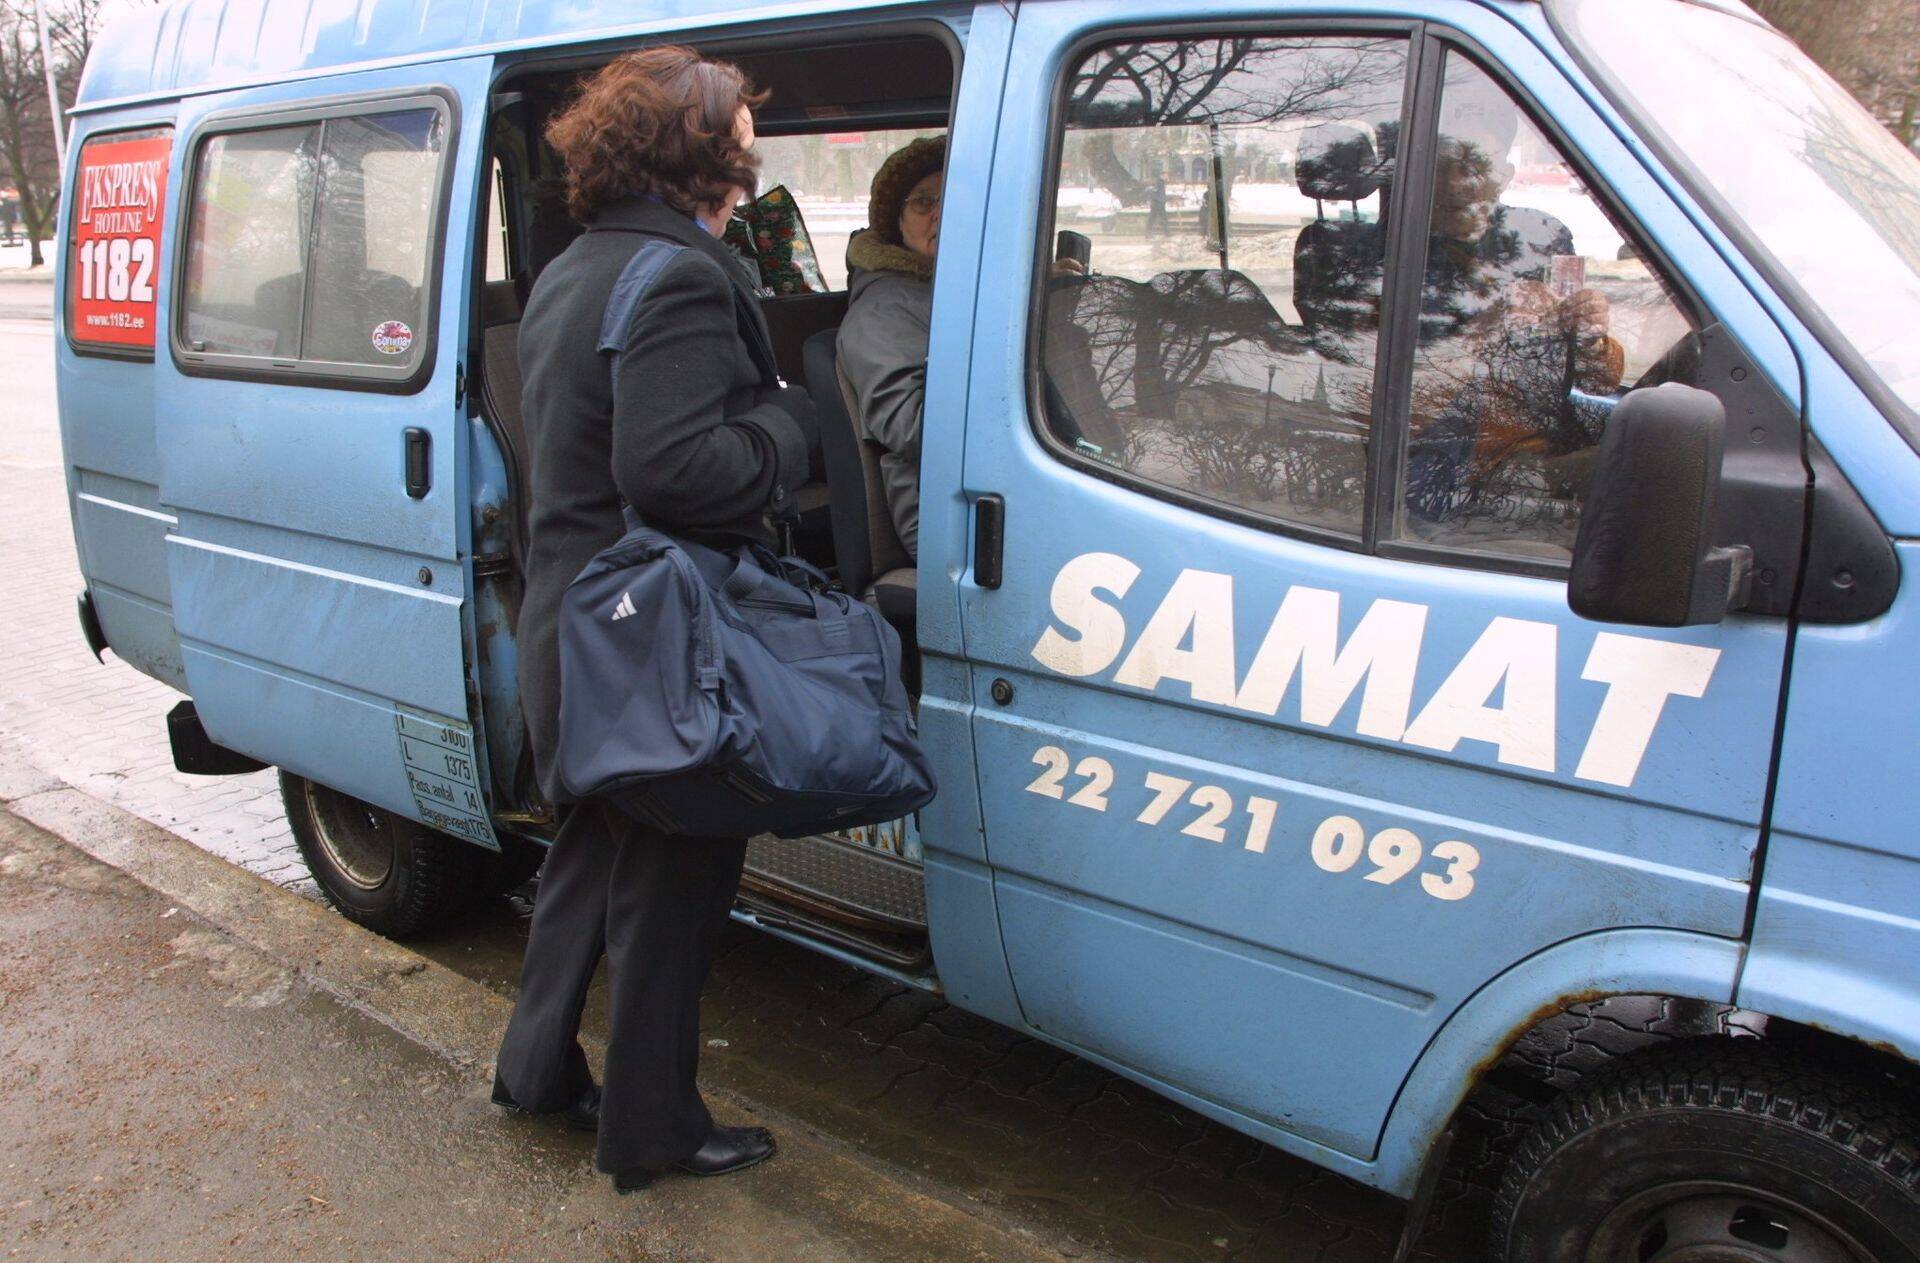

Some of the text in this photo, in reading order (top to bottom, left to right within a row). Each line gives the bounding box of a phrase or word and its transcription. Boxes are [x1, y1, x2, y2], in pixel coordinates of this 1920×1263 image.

[81, 160, 162, 224] EKSPRESS
[94, 211, 144, 234] HOTLINE
[80, 238, 155, 303] 1182
[86, 313, 145, 329] www.1182.ee
[1030, 551, 1722, 788] SAMAT
[444, 754, 471, 781] 1375
[464, 790, 479, 811] 14
[1025, 746, 1481, 901] 22 721 093
